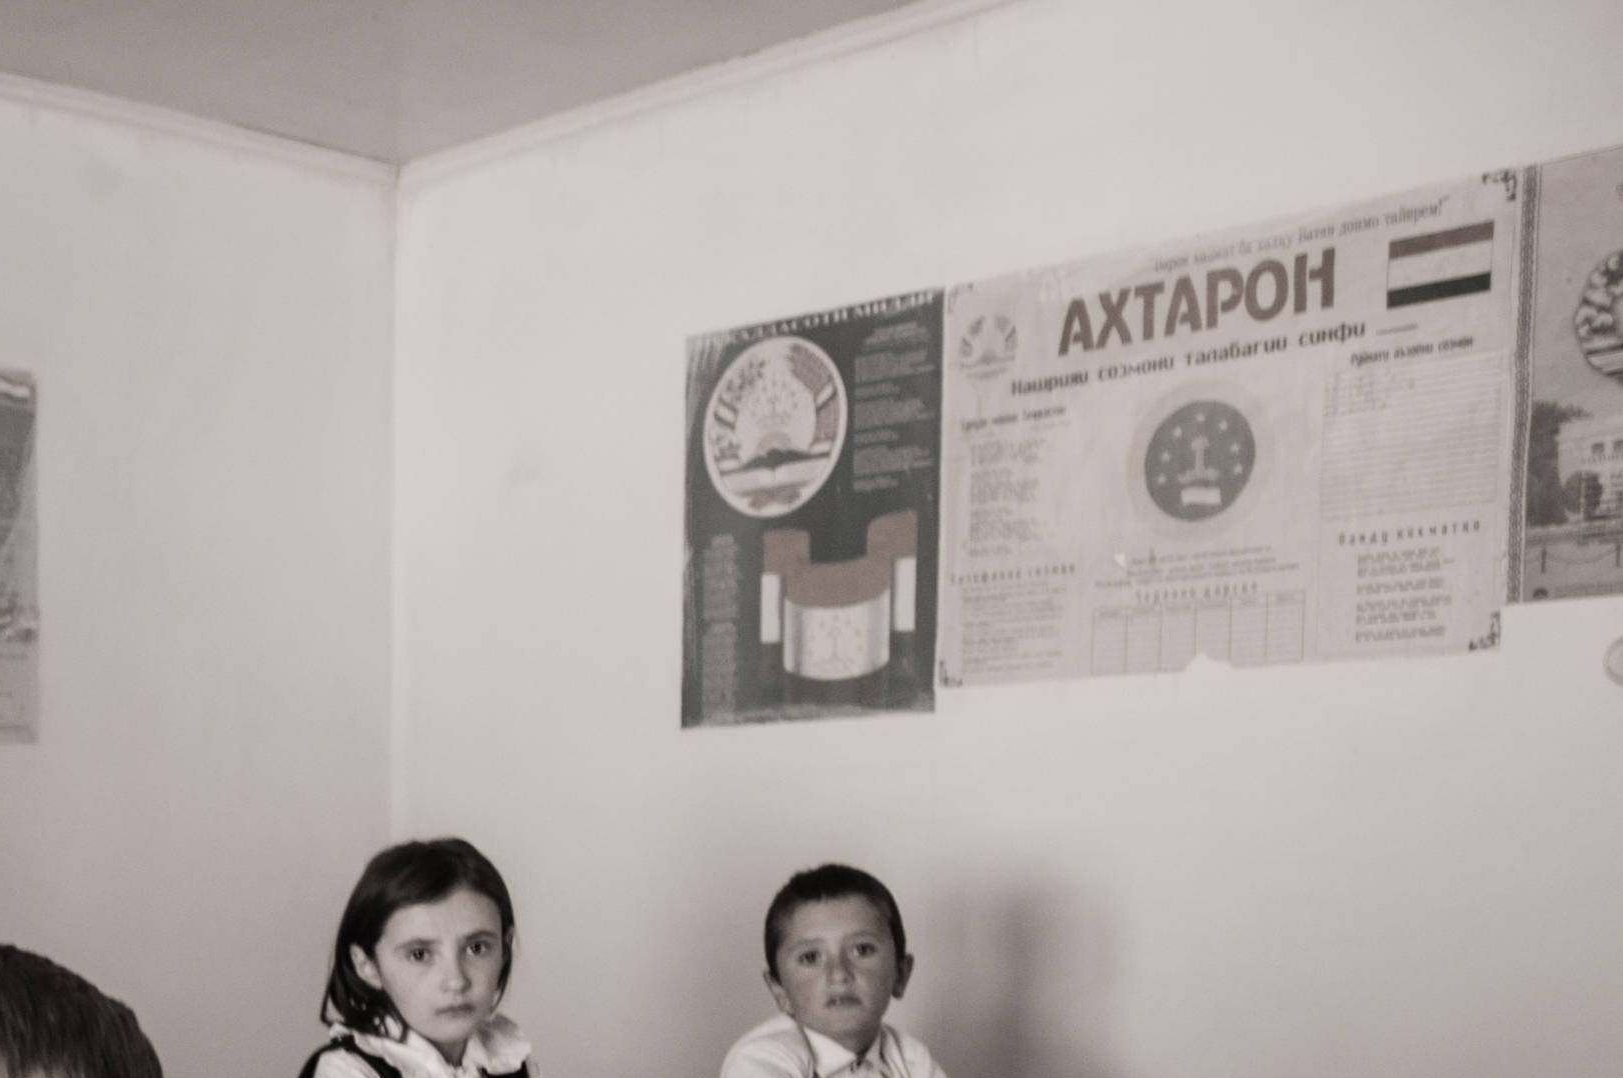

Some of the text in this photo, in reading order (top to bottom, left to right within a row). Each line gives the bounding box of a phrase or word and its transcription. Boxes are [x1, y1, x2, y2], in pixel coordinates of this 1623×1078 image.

[1057, 246, 1336, 357] АХТАРОН
[1097, 356, 1175, 382] созмони
[1184, 335, 1288, 367] талабагии
[1298, 321, 1366, 347] синфи
